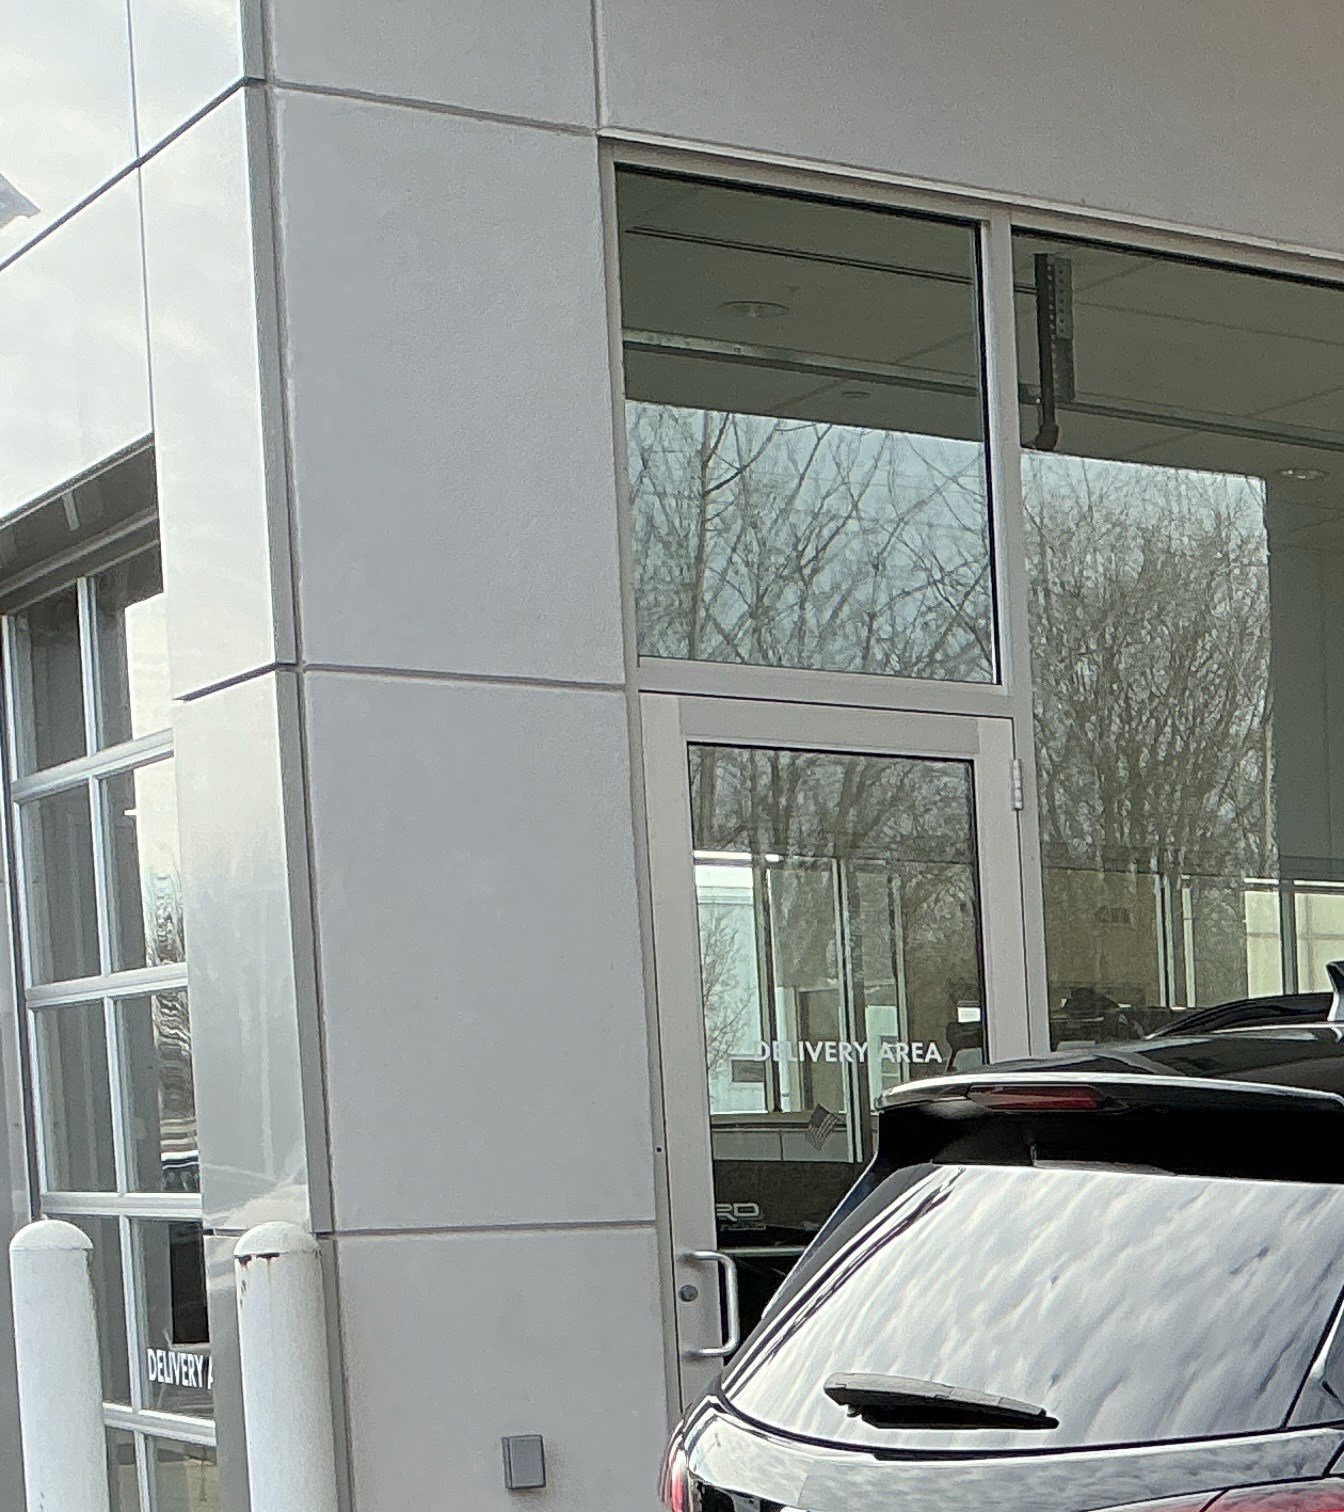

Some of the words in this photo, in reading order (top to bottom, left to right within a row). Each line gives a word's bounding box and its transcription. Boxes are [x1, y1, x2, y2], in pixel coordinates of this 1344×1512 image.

[754, 1040, 868, 1063] DELIVERY
[881, 1041, 943, 1064] AREA
[147, 1348, 203, 1388] DELIVERY
